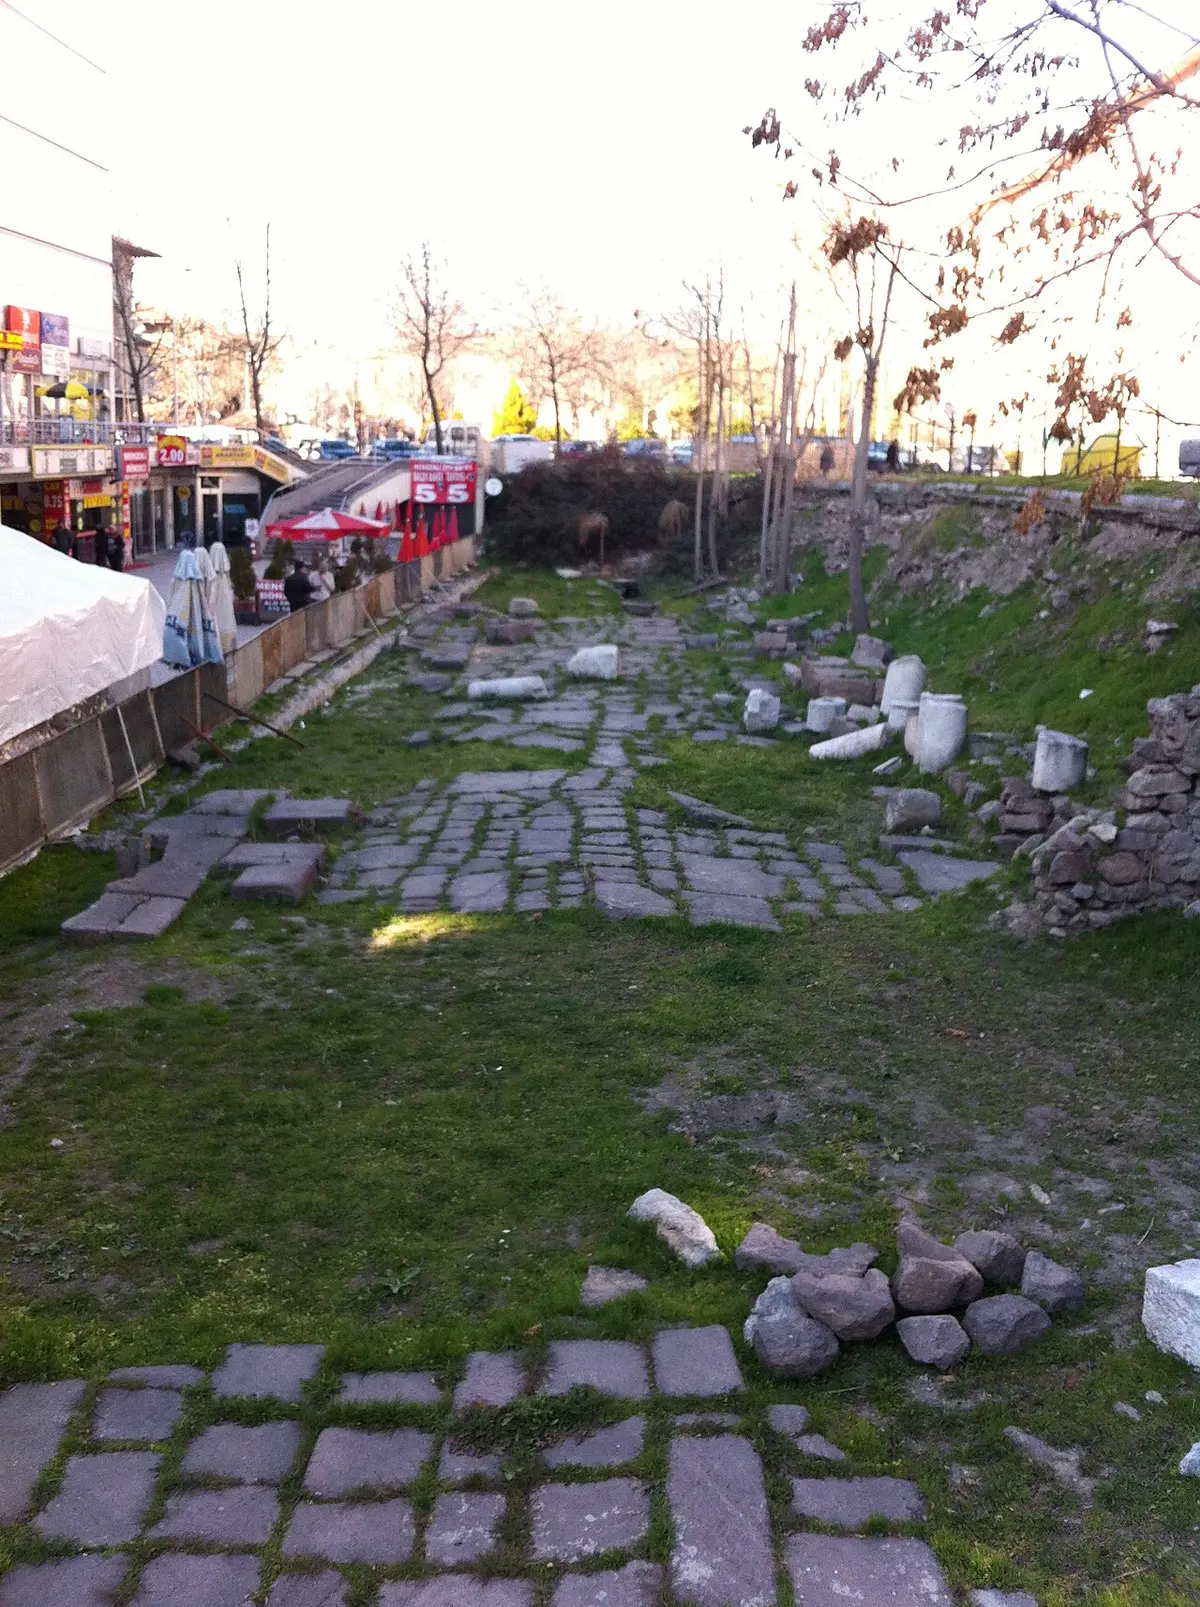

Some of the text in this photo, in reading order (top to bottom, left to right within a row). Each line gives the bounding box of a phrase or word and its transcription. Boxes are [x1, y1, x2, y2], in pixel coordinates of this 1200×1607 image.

[160, 448, 184, 462] 2.00
[415, 483, 469, 502] 5 5
